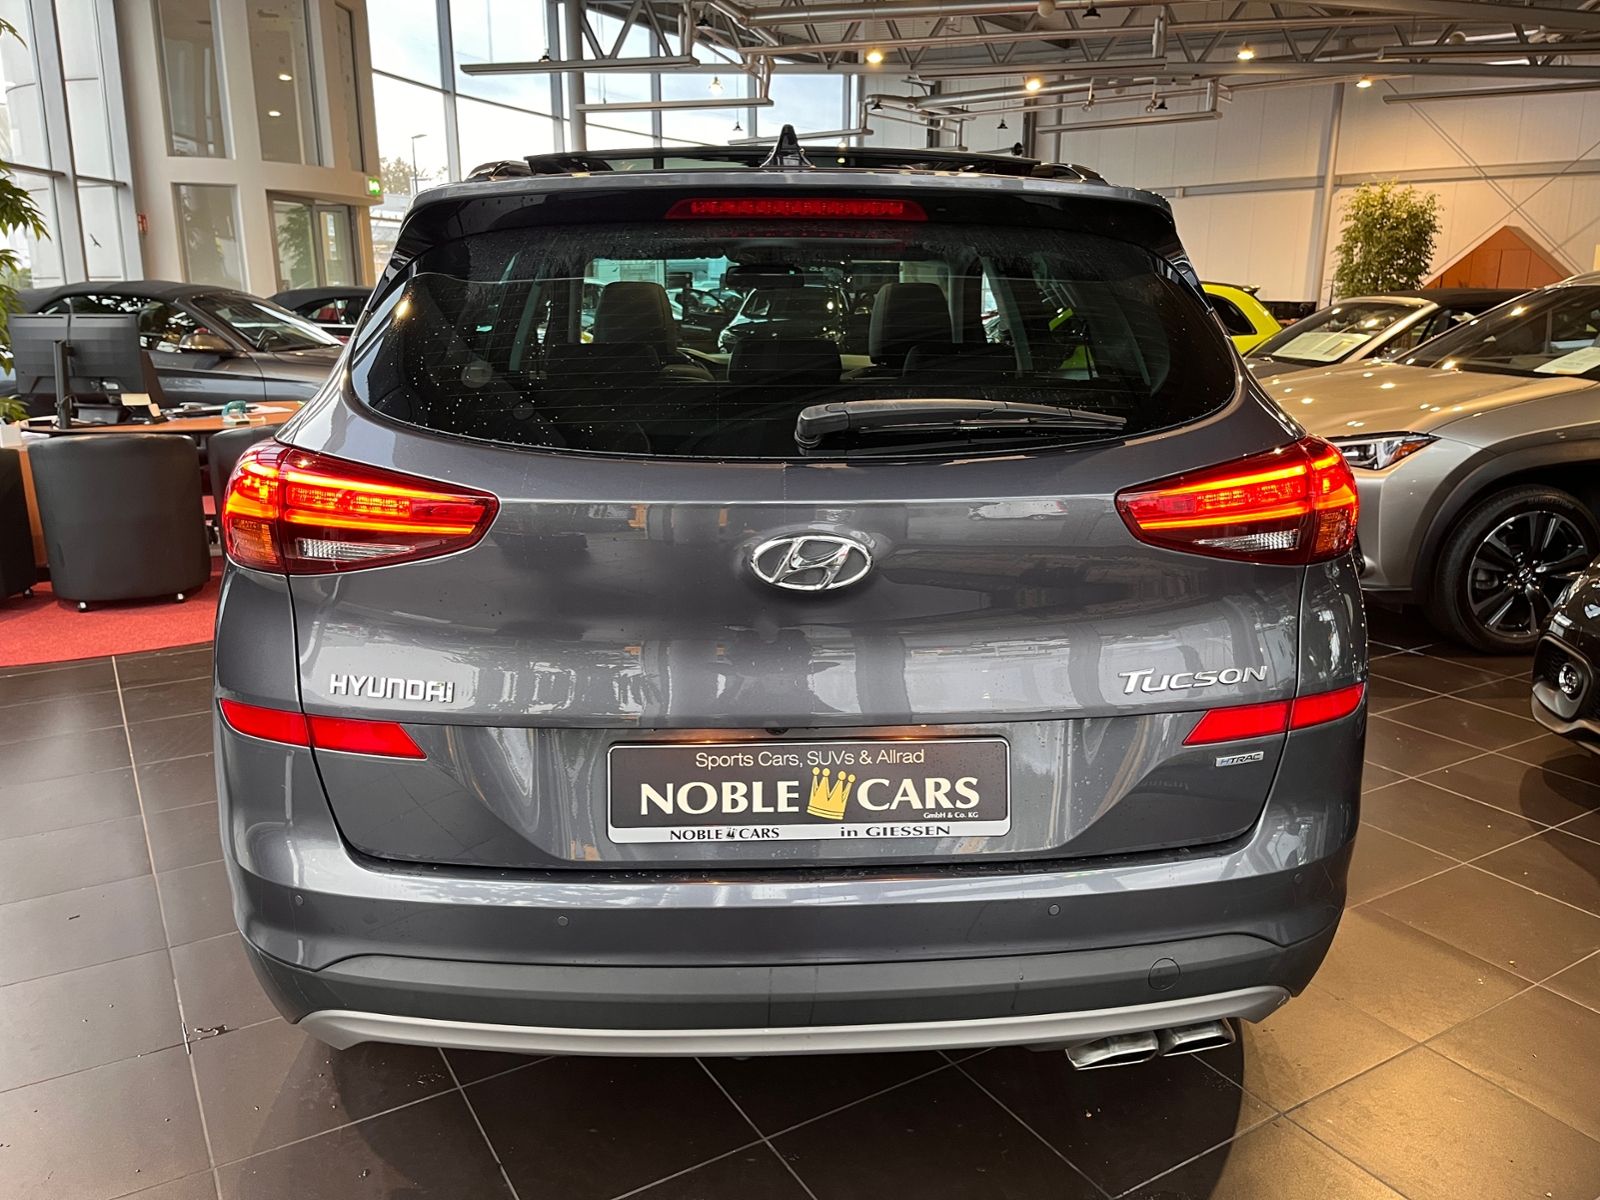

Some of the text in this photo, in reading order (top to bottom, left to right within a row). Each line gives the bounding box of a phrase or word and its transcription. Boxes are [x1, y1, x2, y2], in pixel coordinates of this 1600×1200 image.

[329, 673, 455, 703] HYUNDAI
[1118, 665, 1268, 694] TUCSON
[695, 749, 925, 770] Sports Cars, SUVs & Allrad
[1220, 753, 1262, 766] HTRAC
[640, 777, 980, 815] NOBLE CARS
[954, 811, 967, 819] Co.
[670, 825, 951, 840] NOBLE CARS in GIESSEN
